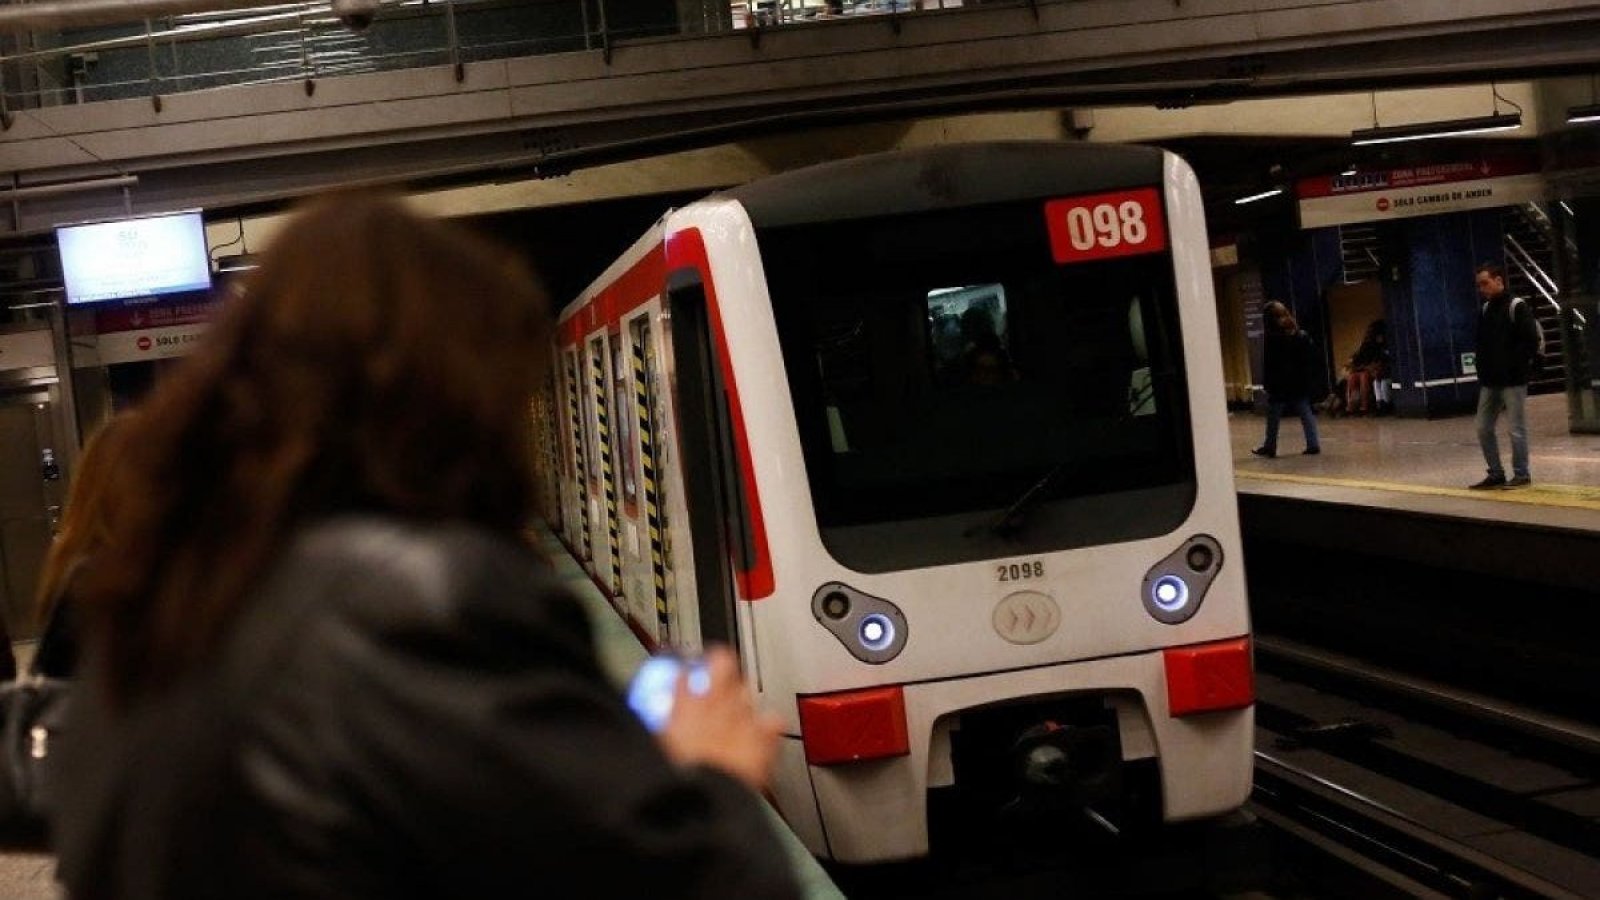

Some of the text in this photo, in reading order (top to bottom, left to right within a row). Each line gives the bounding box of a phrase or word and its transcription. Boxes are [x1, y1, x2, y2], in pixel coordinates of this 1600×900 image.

[1394, 196, 1414, 207] SOLO
[1417, 192, 1450, 204] CAMBIO
[1452, 191, 1462, 200] DE
[1067, 200, 1147, 251] 098
[156, 335, 179, 346] SOLO
[997, 561, 1044, 581] 2098
